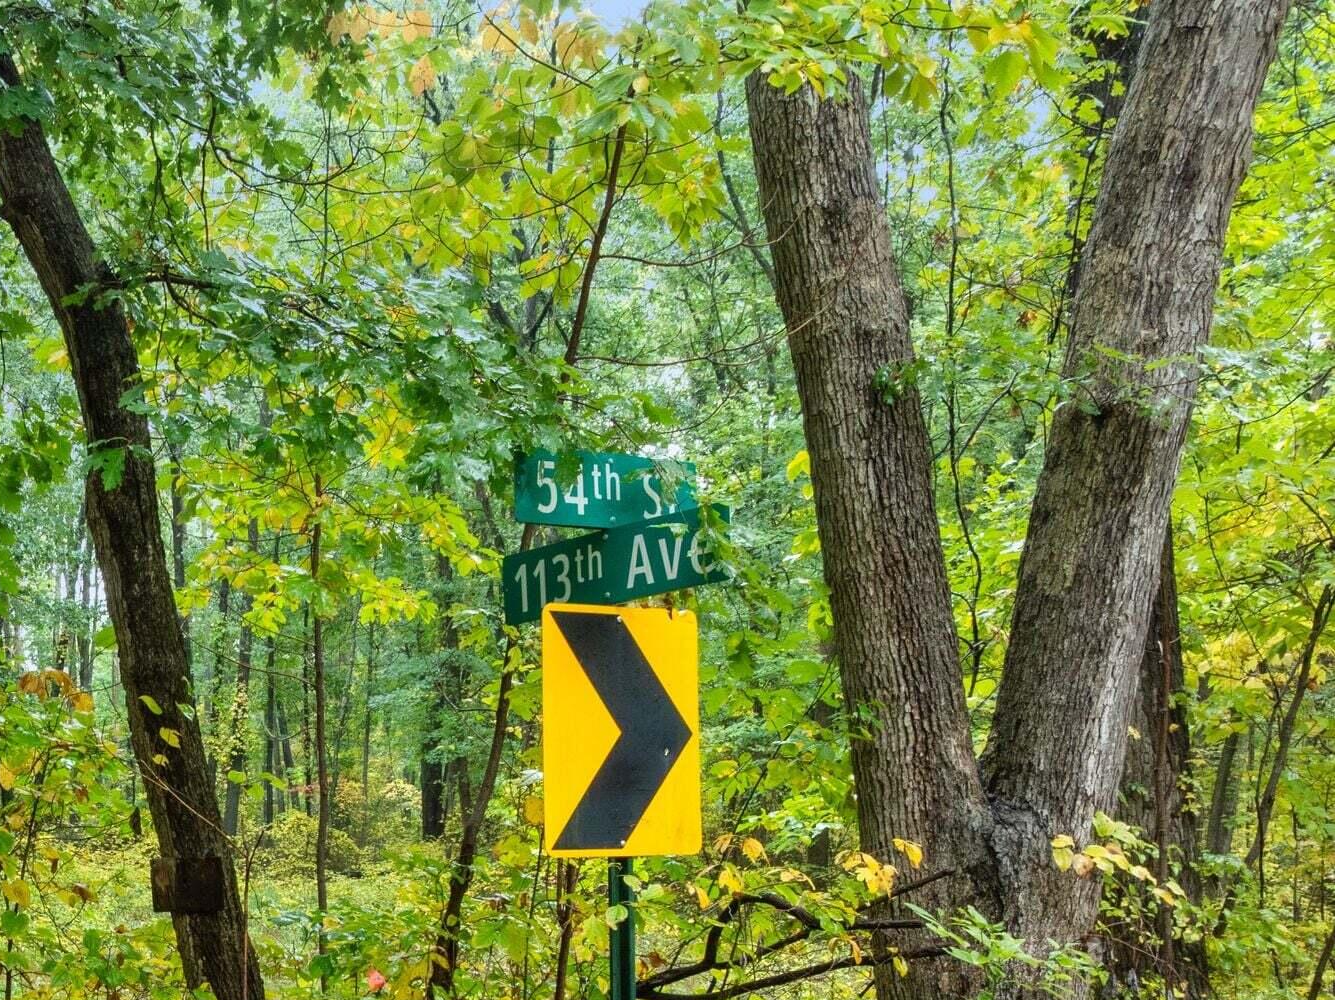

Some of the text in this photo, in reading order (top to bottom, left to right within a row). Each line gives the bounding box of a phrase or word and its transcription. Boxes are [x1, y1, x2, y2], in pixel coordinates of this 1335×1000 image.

[536, 460, 676, 519] 54th S
[514, 530, 715, 614] 113th Ave
